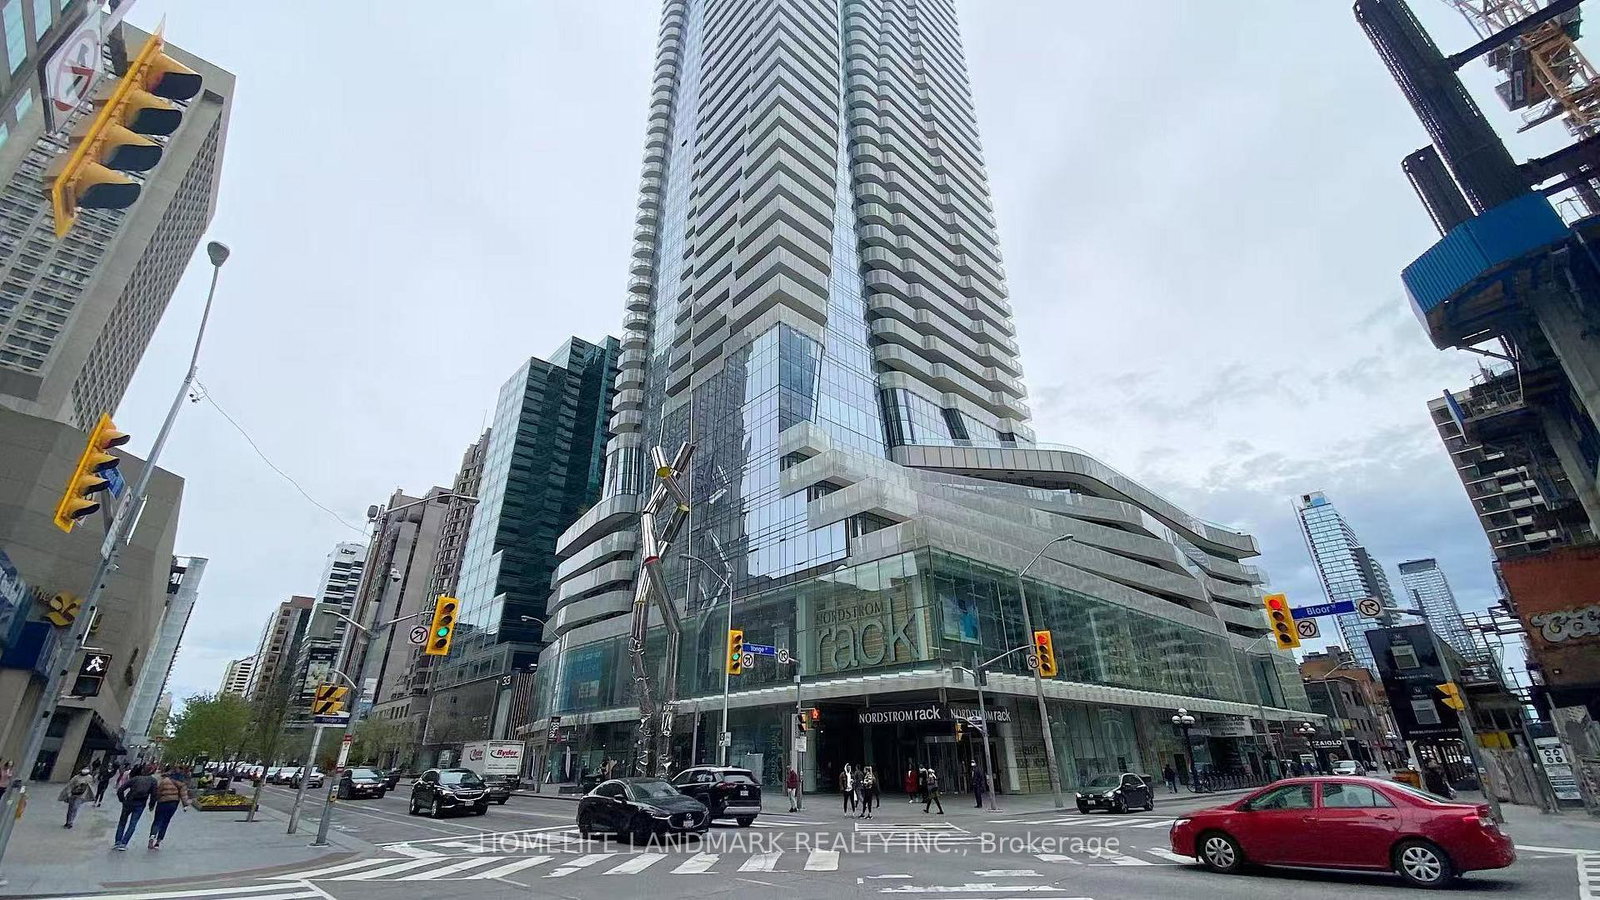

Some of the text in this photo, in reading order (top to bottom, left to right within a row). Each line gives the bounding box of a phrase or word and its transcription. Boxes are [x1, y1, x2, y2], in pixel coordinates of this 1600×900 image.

[817, 601, 883, 624] NORDSTROM
[1305, 606, 1330, 616] Bloor
[816, 598, 920, 672] rack
[750, 645, 765, 653] Yonge
[501, 675, 511, 686] 33
[859, 705, 941, 723] NORDSTROM rack
[993, 708, 1012, 722] rack
[497, 749, 518, 757] Ryder
